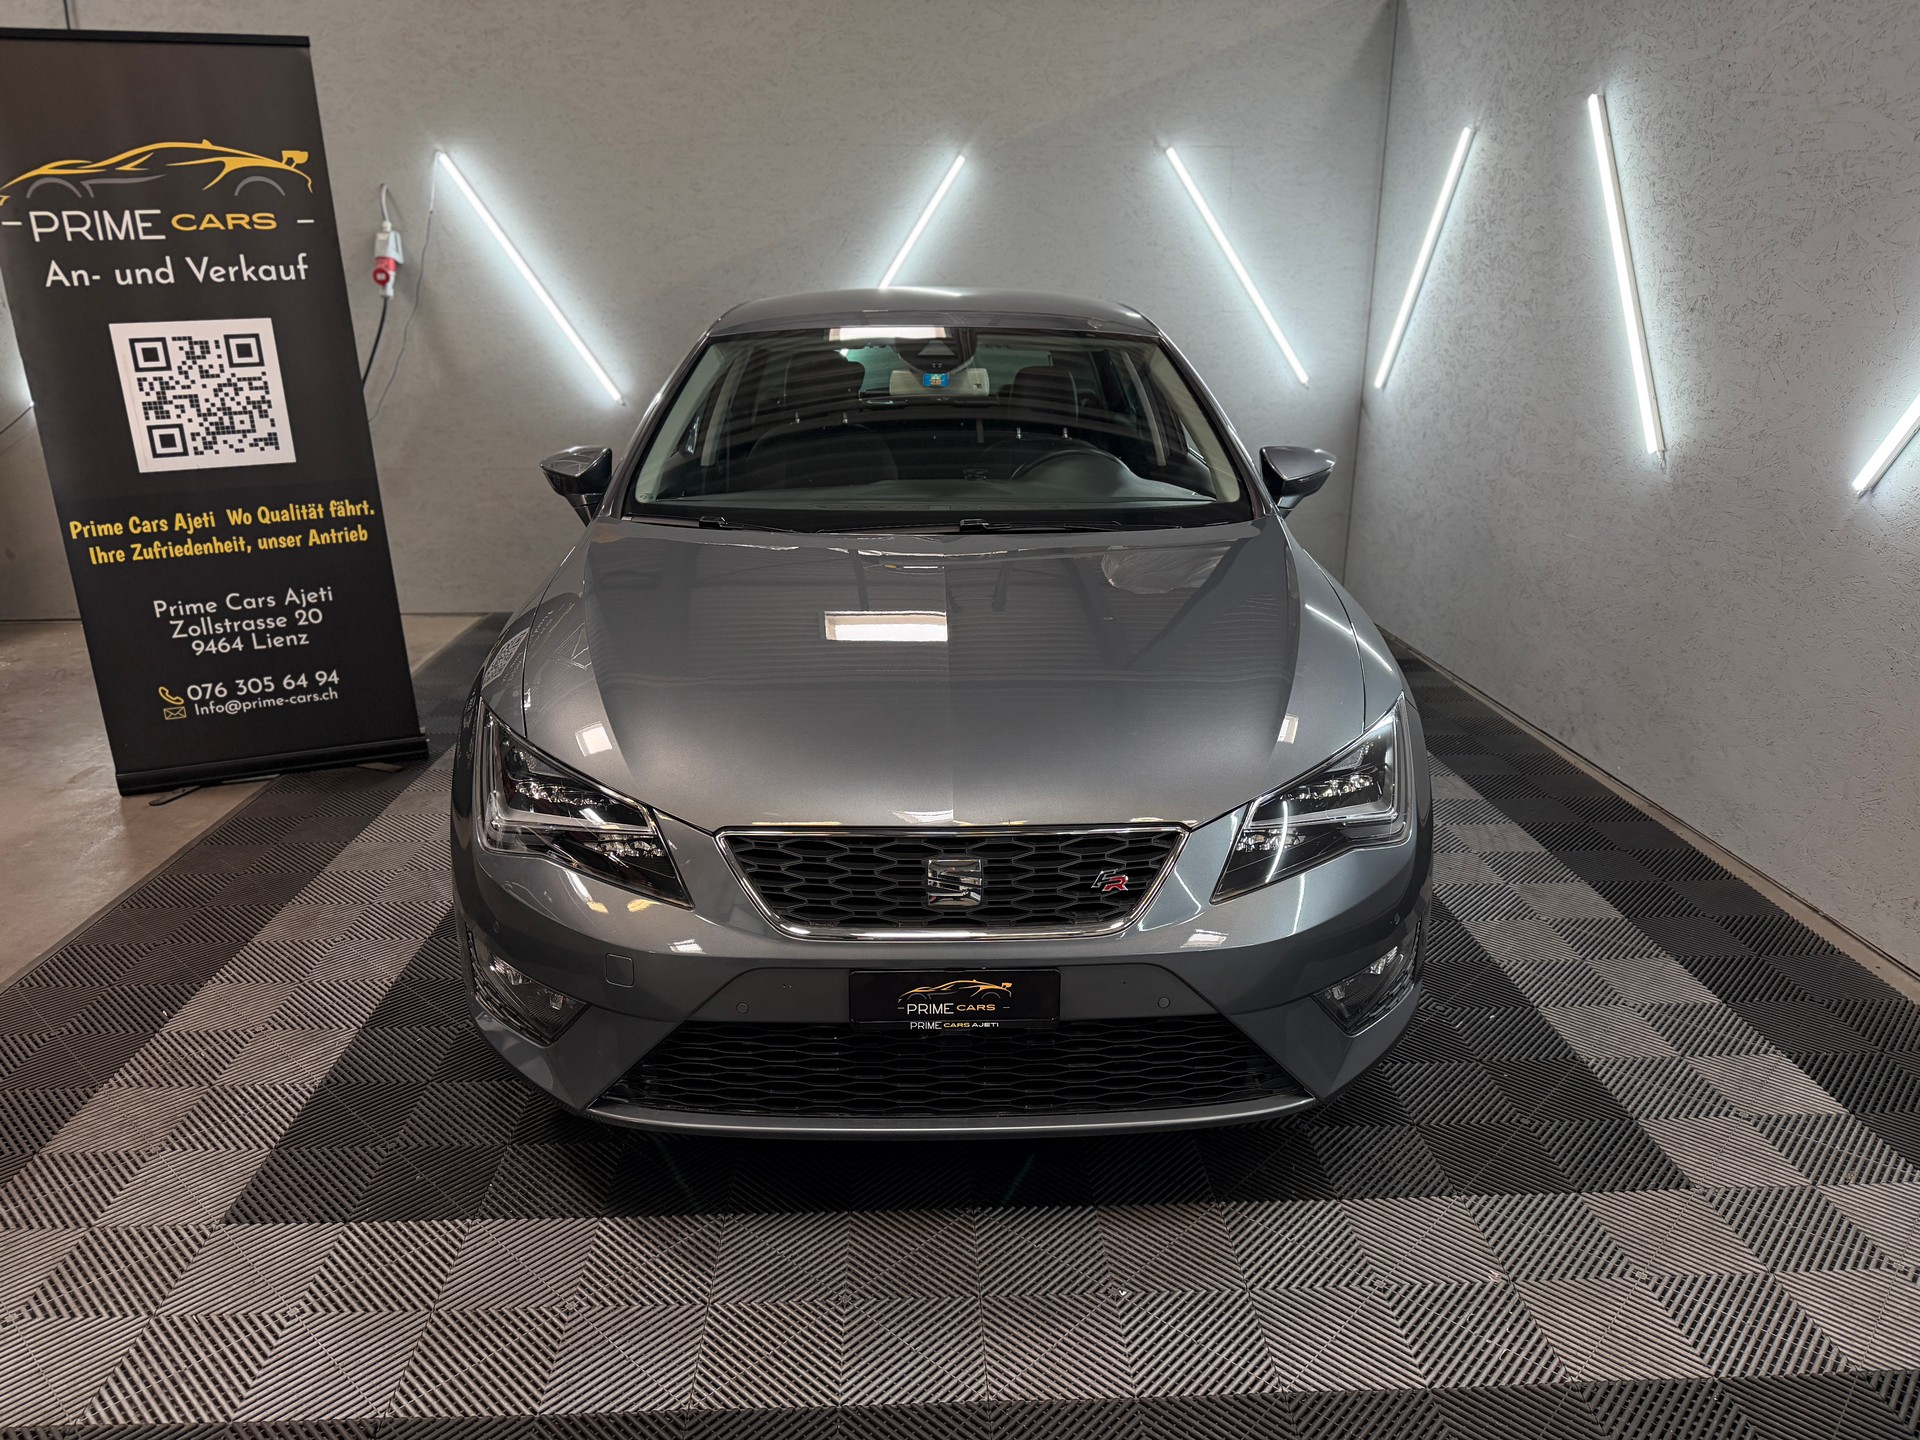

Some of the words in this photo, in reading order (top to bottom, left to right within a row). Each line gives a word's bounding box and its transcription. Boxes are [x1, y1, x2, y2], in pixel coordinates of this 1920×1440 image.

[28, 209, 166, 242] PRIME
[171, 213, 277, 231] CARS
[46, 259, 100, 287] An-
[115, 256, 174, 285] und
[185, 253, 308, 283] Verkauf
[70, 521, 123, 539] Prime
[129, 516, 168, 534] Cars
[174, 511, 215, 533] Ajeti
[226, 509, 251, 525] Wo
[257, 503, 324, 525] Qualität
[329, 500, 375, 517] fährt.
[89, 546, 125, 564] Ihre
[131, 536, 251, 561] Zufriedenheit,
[258, 534, 302, 550] unser
[308, 525, 368, 546] Antrieb
[154, 600, 217, 618] Prime
[226, 593, 276, 610] Cars
[285, 587, 333, 607] Ajeti
[170, 615, 287, 638] Zollstrasse
[295, 608, 323, 626] 20
[192, 637, 244, 655] 9464
[252, 632, 309, 650] Lienz
[187, 683, 227, 700] 076
[235, 677, 275, 695] 305
[283, 673, 308, 690] 64
[315, 670, 339, 685] 94
[195, 689, 338, 715] Info@prime-cars.ch
[1091, 868, 1128, 892] FR
[907, 1003, 954, 1014] PRIME
